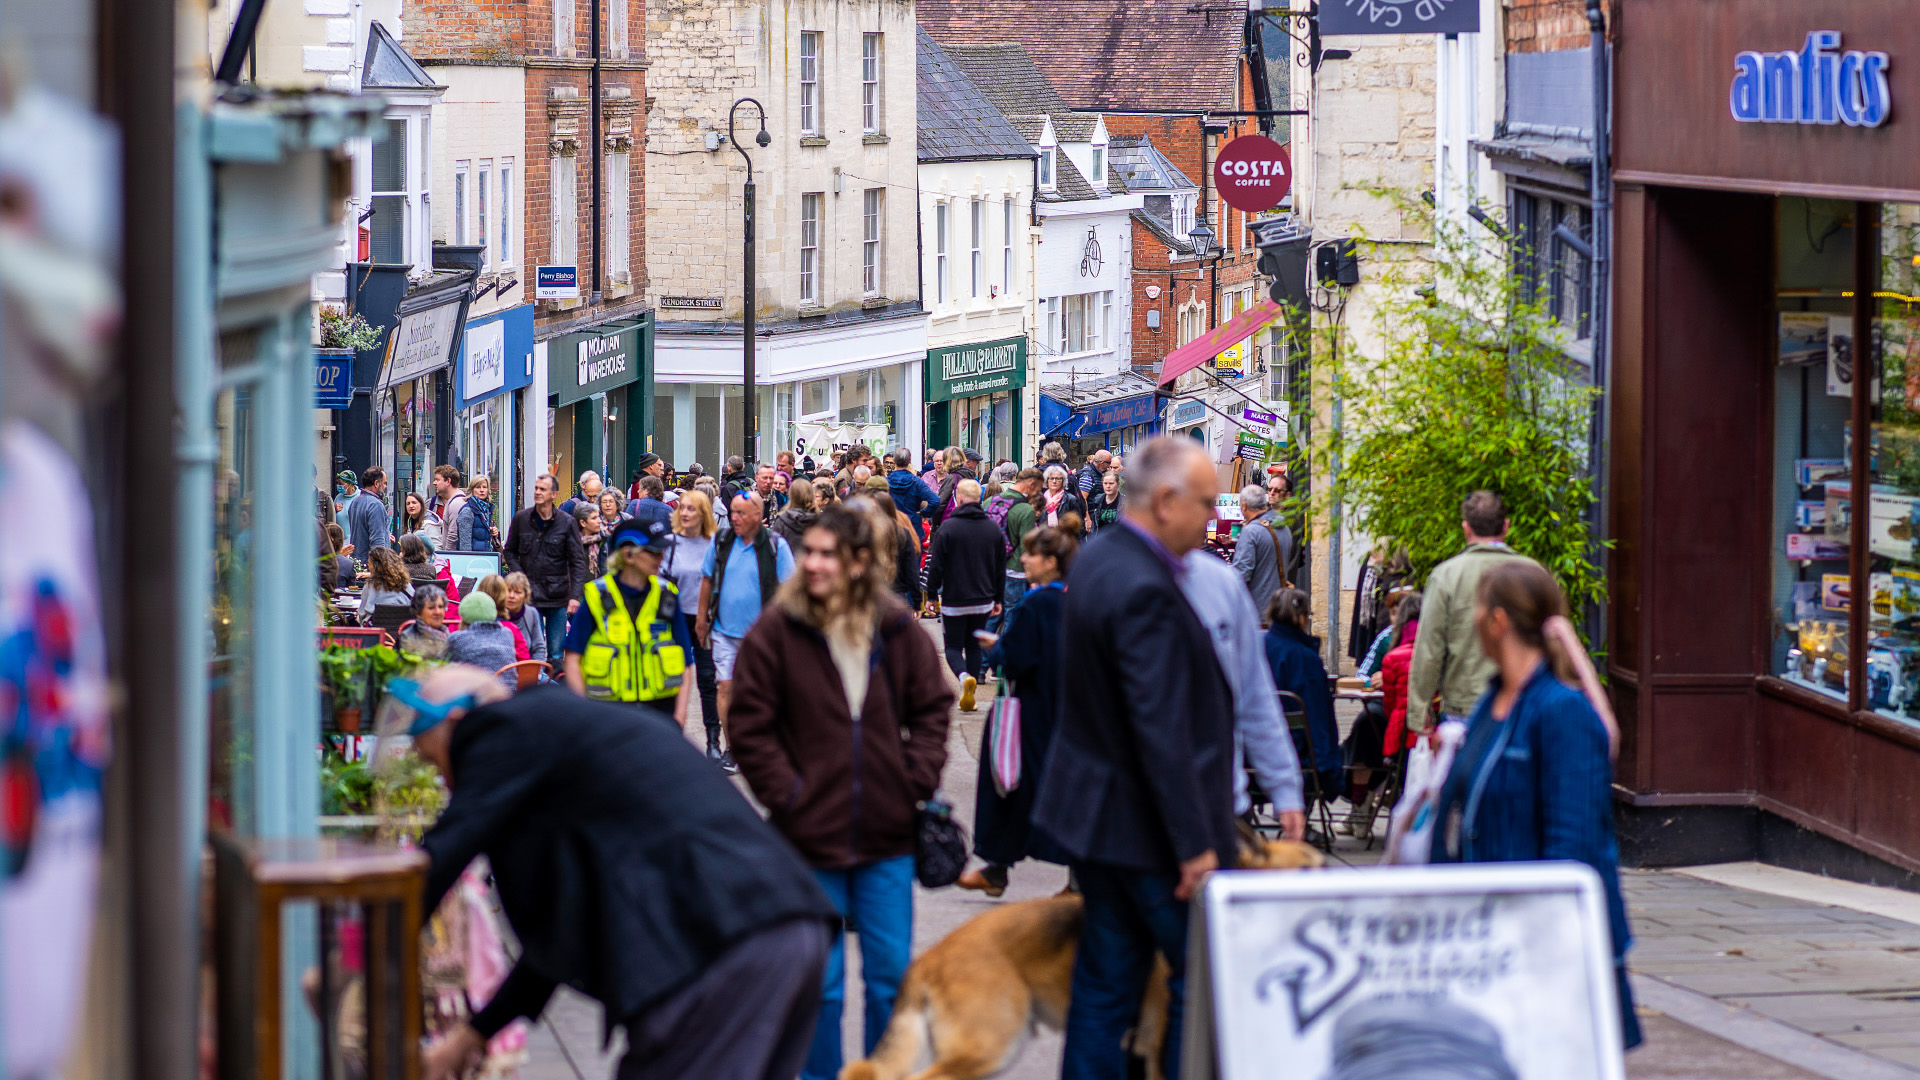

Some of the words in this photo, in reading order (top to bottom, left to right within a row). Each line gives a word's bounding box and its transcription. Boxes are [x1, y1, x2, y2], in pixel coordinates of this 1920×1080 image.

[1730, 30, 1891, 128] antics
[1220, 160, 1285, 177] COSTA
[1235, 179, 1271, 187] COFFEE
[540, 272, 555, 280] Perry
[555, 272, 575, 280] Bishop
[695, 299, 721, 307] STREET
[588, 352, 626, 382] WAREHOUSE
[942, 350, 977, 381] HOLLAND
[976, 348, 985, 376] &
[984, 343, 1018, 370] BARRETT
[1218, 358, 1242, 368] savills
[951, 381, 964, 395] health
[963, 381, 975, 392] foods
[978, 377, 992, 389] natural
[991, 375, 1009, 388] remedies
[1096, 409, 1113, 427] Penny
[1250, 412, 1269, 421] MAKE
[1245, 423, 1271, 435] VOTES
[1292, 896, 1497, 986] Stroud
